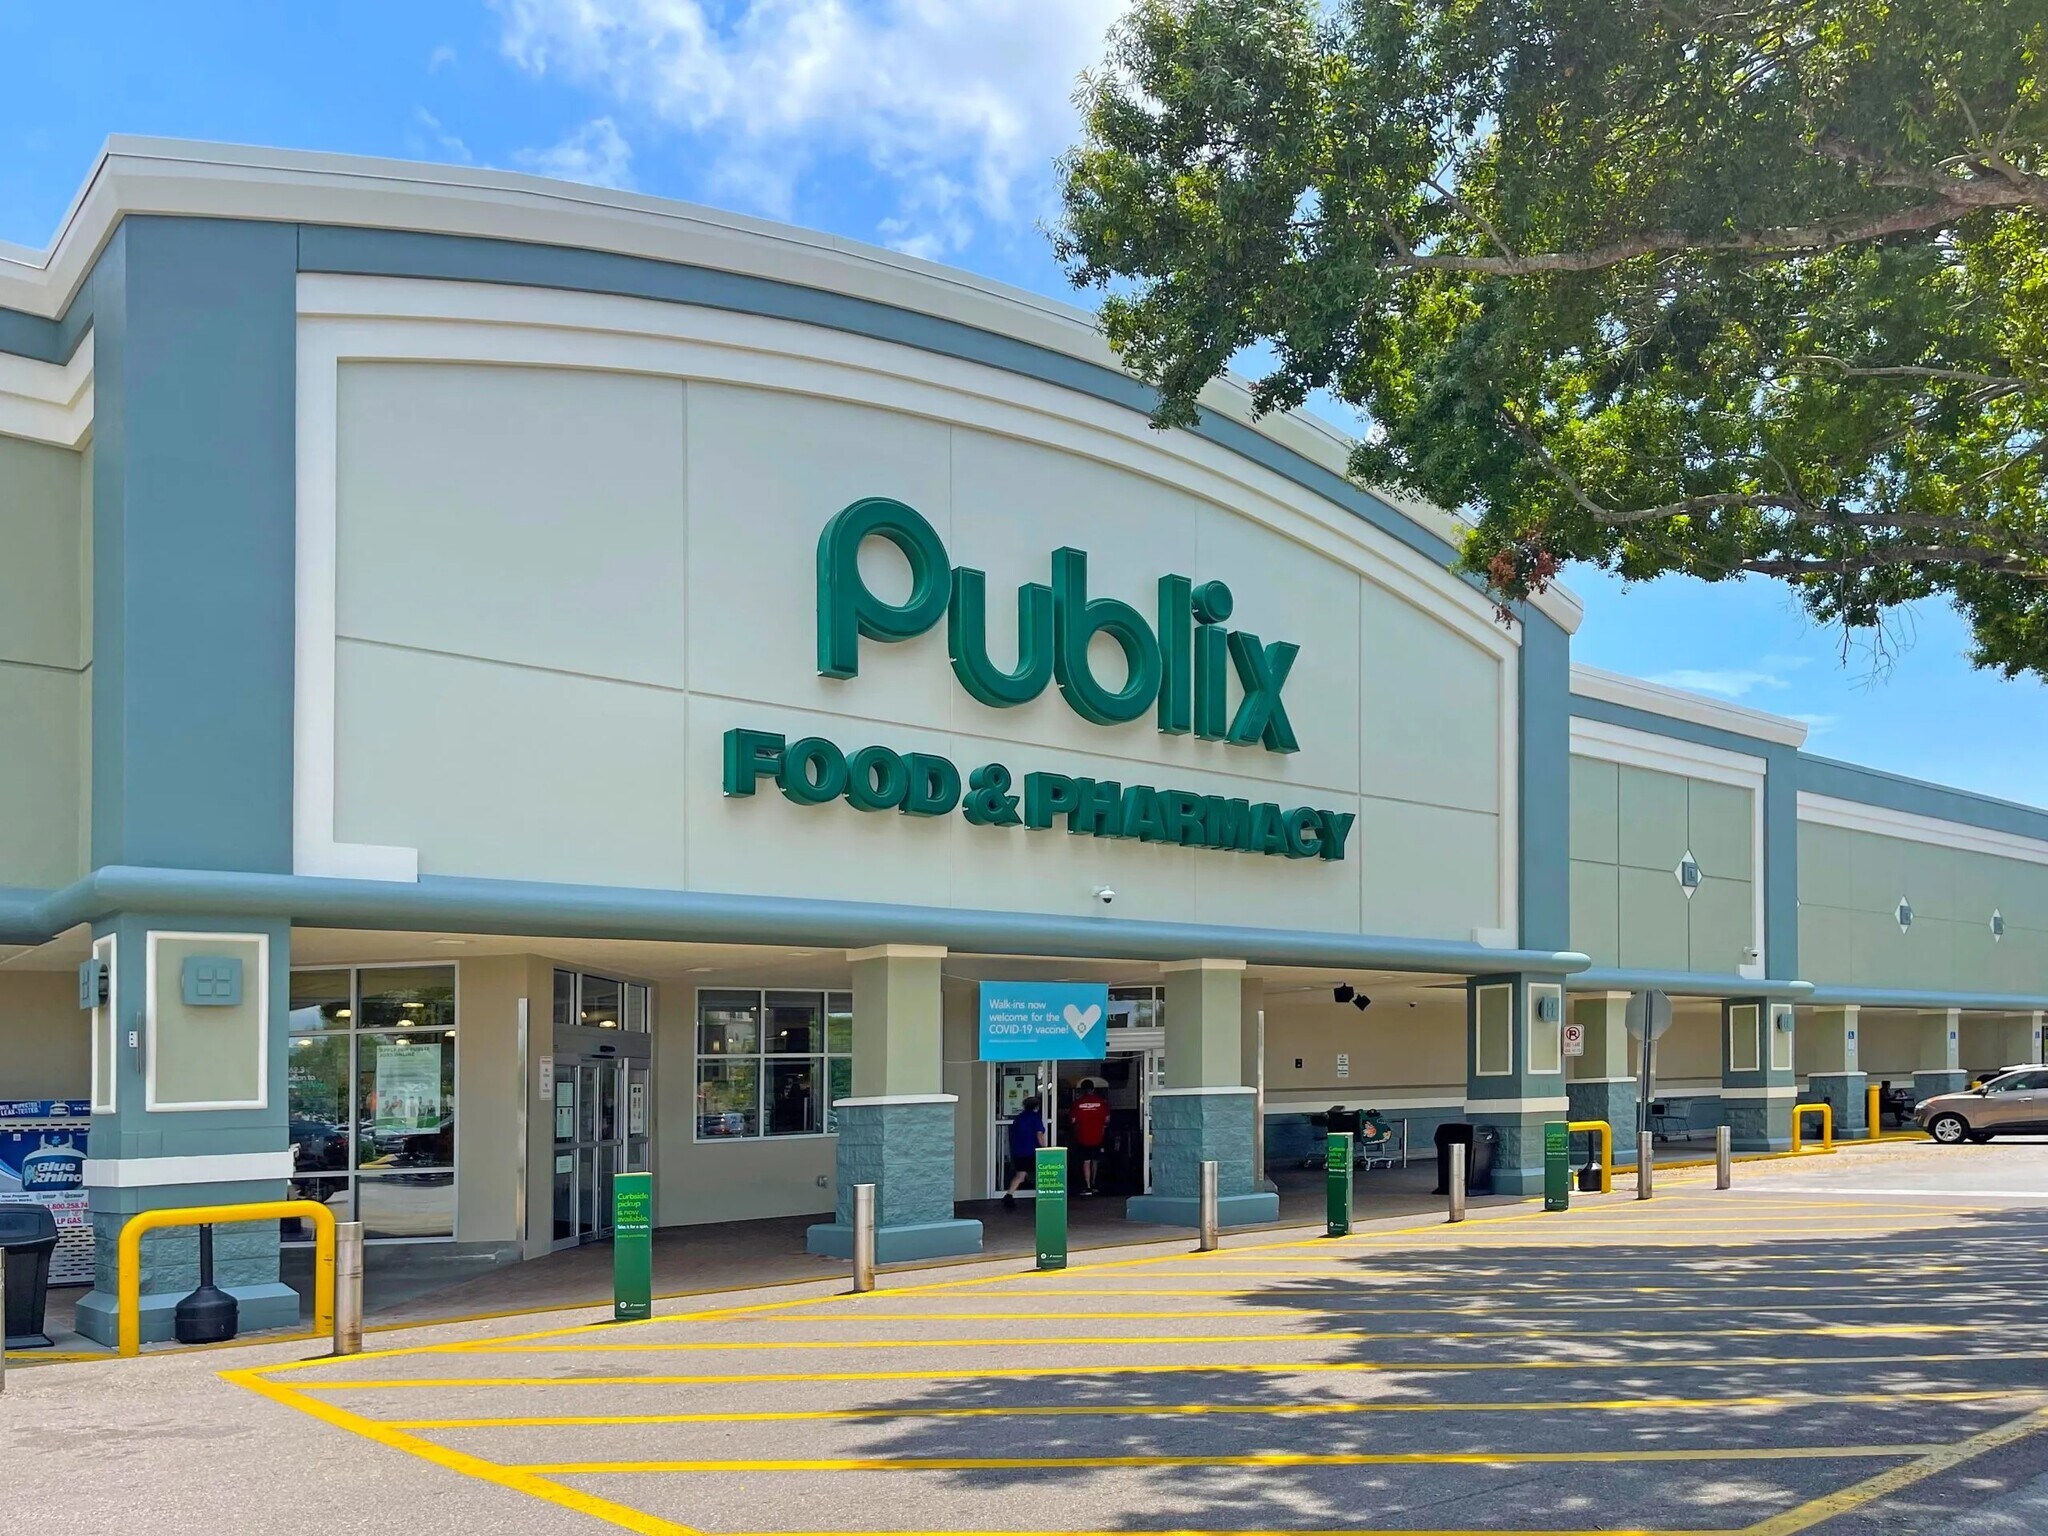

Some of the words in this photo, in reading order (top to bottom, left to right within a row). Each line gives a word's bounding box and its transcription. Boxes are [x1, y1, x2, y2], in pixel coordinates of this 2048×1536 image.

[817, 497, 1300, 753] Publix
[723, 728, 961, 817] FOOD
[963, 763, 1022, 826] &
[1025, 771, 1356, 861] PHARMACY
[989, 999, 1025, 1009] Walk-ins
[989, 1013, 1028, 1022] welcome
[1031, 1013, 1043, 1022] for
[1046, 1013, 1060, 1022] the
[989, 1025, 1032, 1034] COVID-19
[1035, 1025, 1069, 1034] vaccine!
[37, 1162, 76, 1171] Blue
[33, 1172, 82, 1183] Rhino
[617, 1200, 641, 1209] pickup
